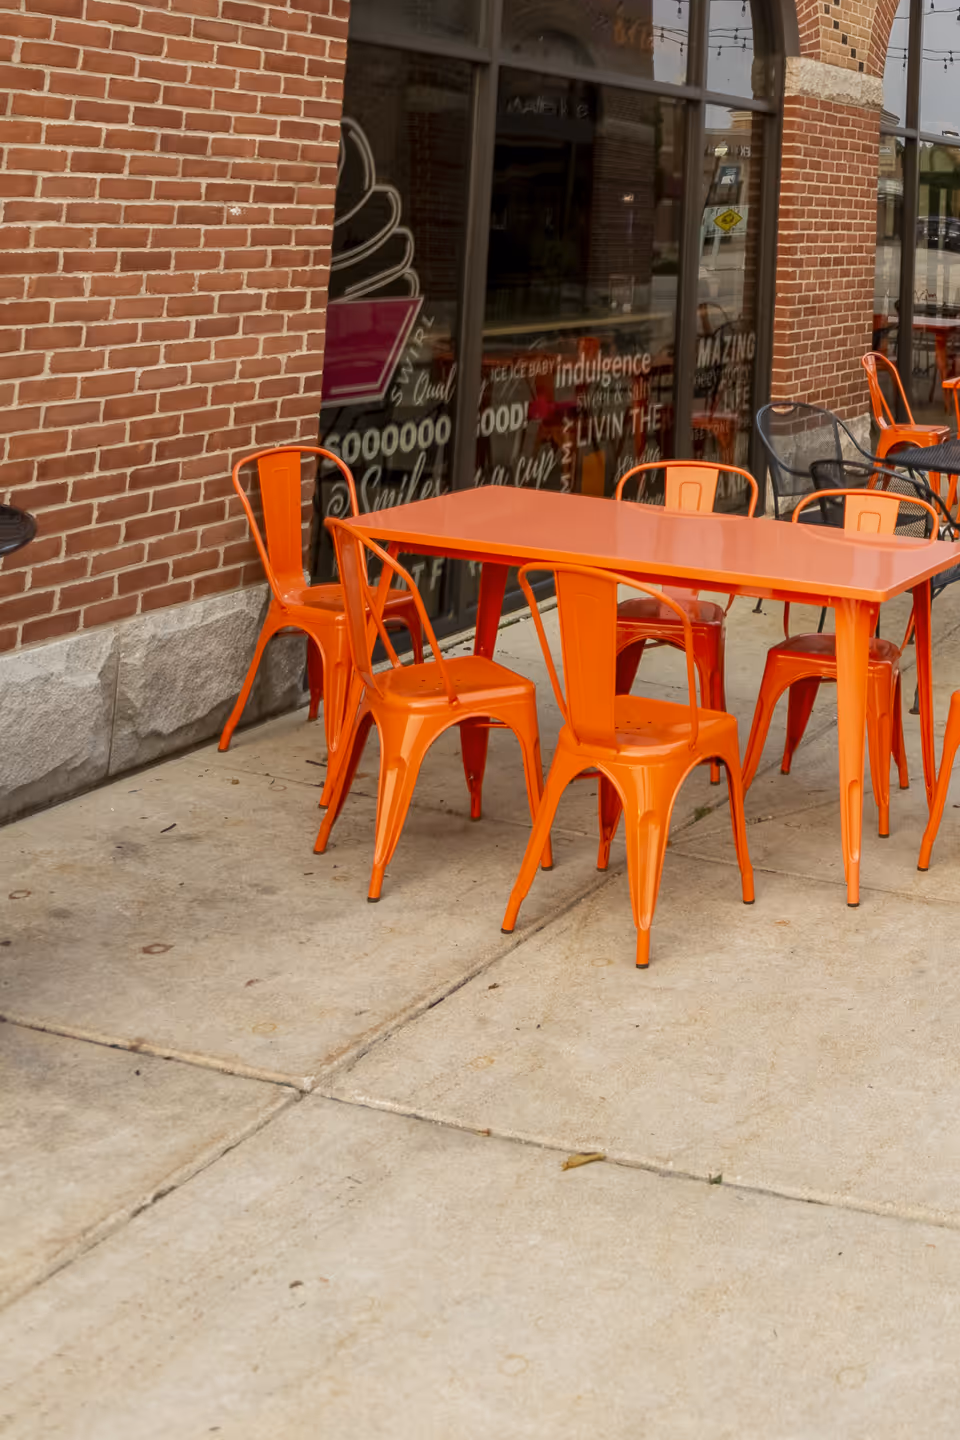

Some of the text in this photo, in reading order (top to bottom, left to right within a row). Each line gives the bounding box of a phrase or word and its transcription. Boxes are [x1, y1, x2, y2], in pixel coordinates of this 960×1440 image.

[391, 314, 435, 407] SWIRL
[490, 357, 555, 383] ICE ICE BABY
[555, 349, 652, 389] indulgence
[476, 400, 530, 437] OOD!
[576, 410, 625, 447] LIVIN
[629, 401, 664, 435] THE
